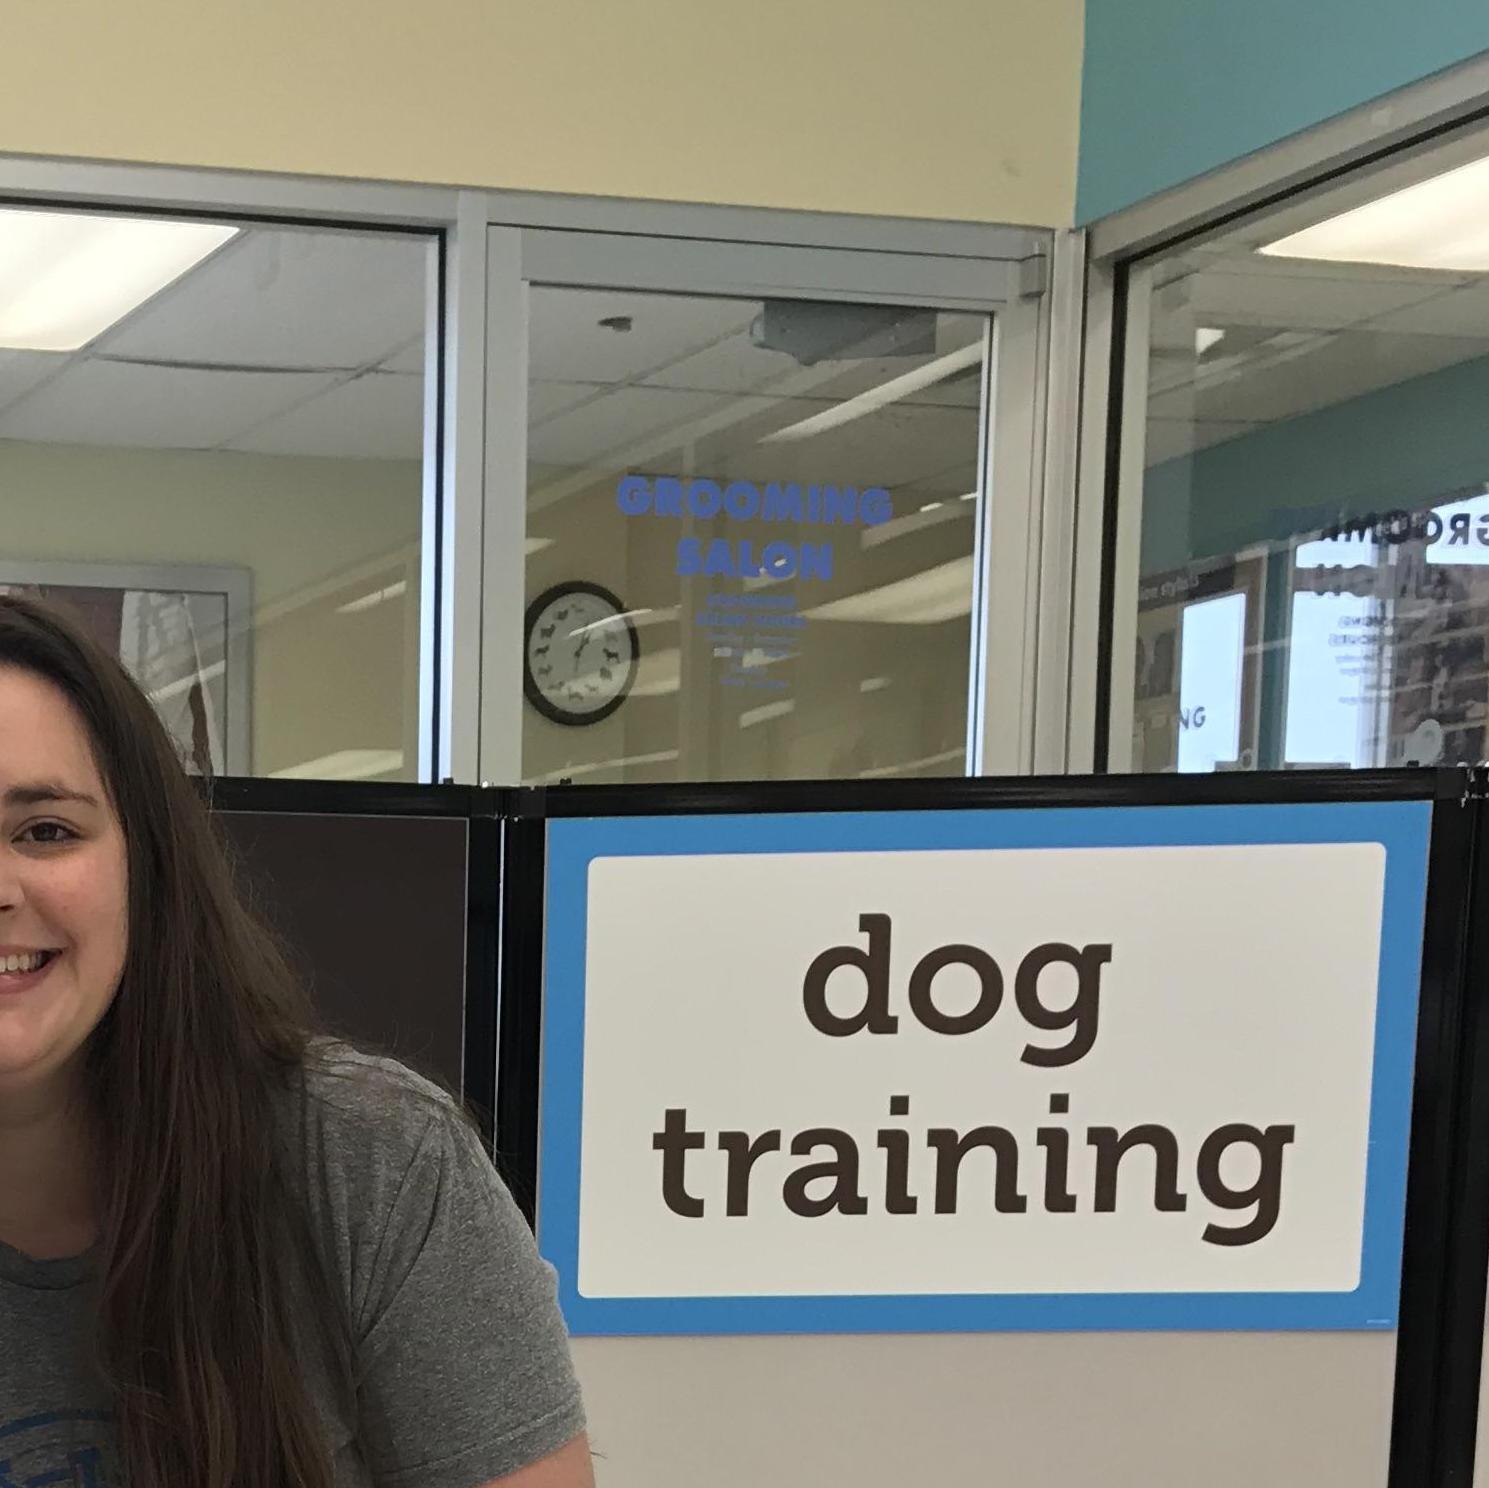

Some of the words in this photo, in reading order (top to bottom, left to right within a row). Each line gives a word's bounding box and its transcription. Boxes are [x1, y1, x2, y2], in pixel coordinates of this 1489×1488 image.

[617, 474, 893, 526] GROOMING
[675, 537, 833, 582] SALON
[801, 912, 1113, 1068] dog
[652, 1093, 1296, 1247] training
